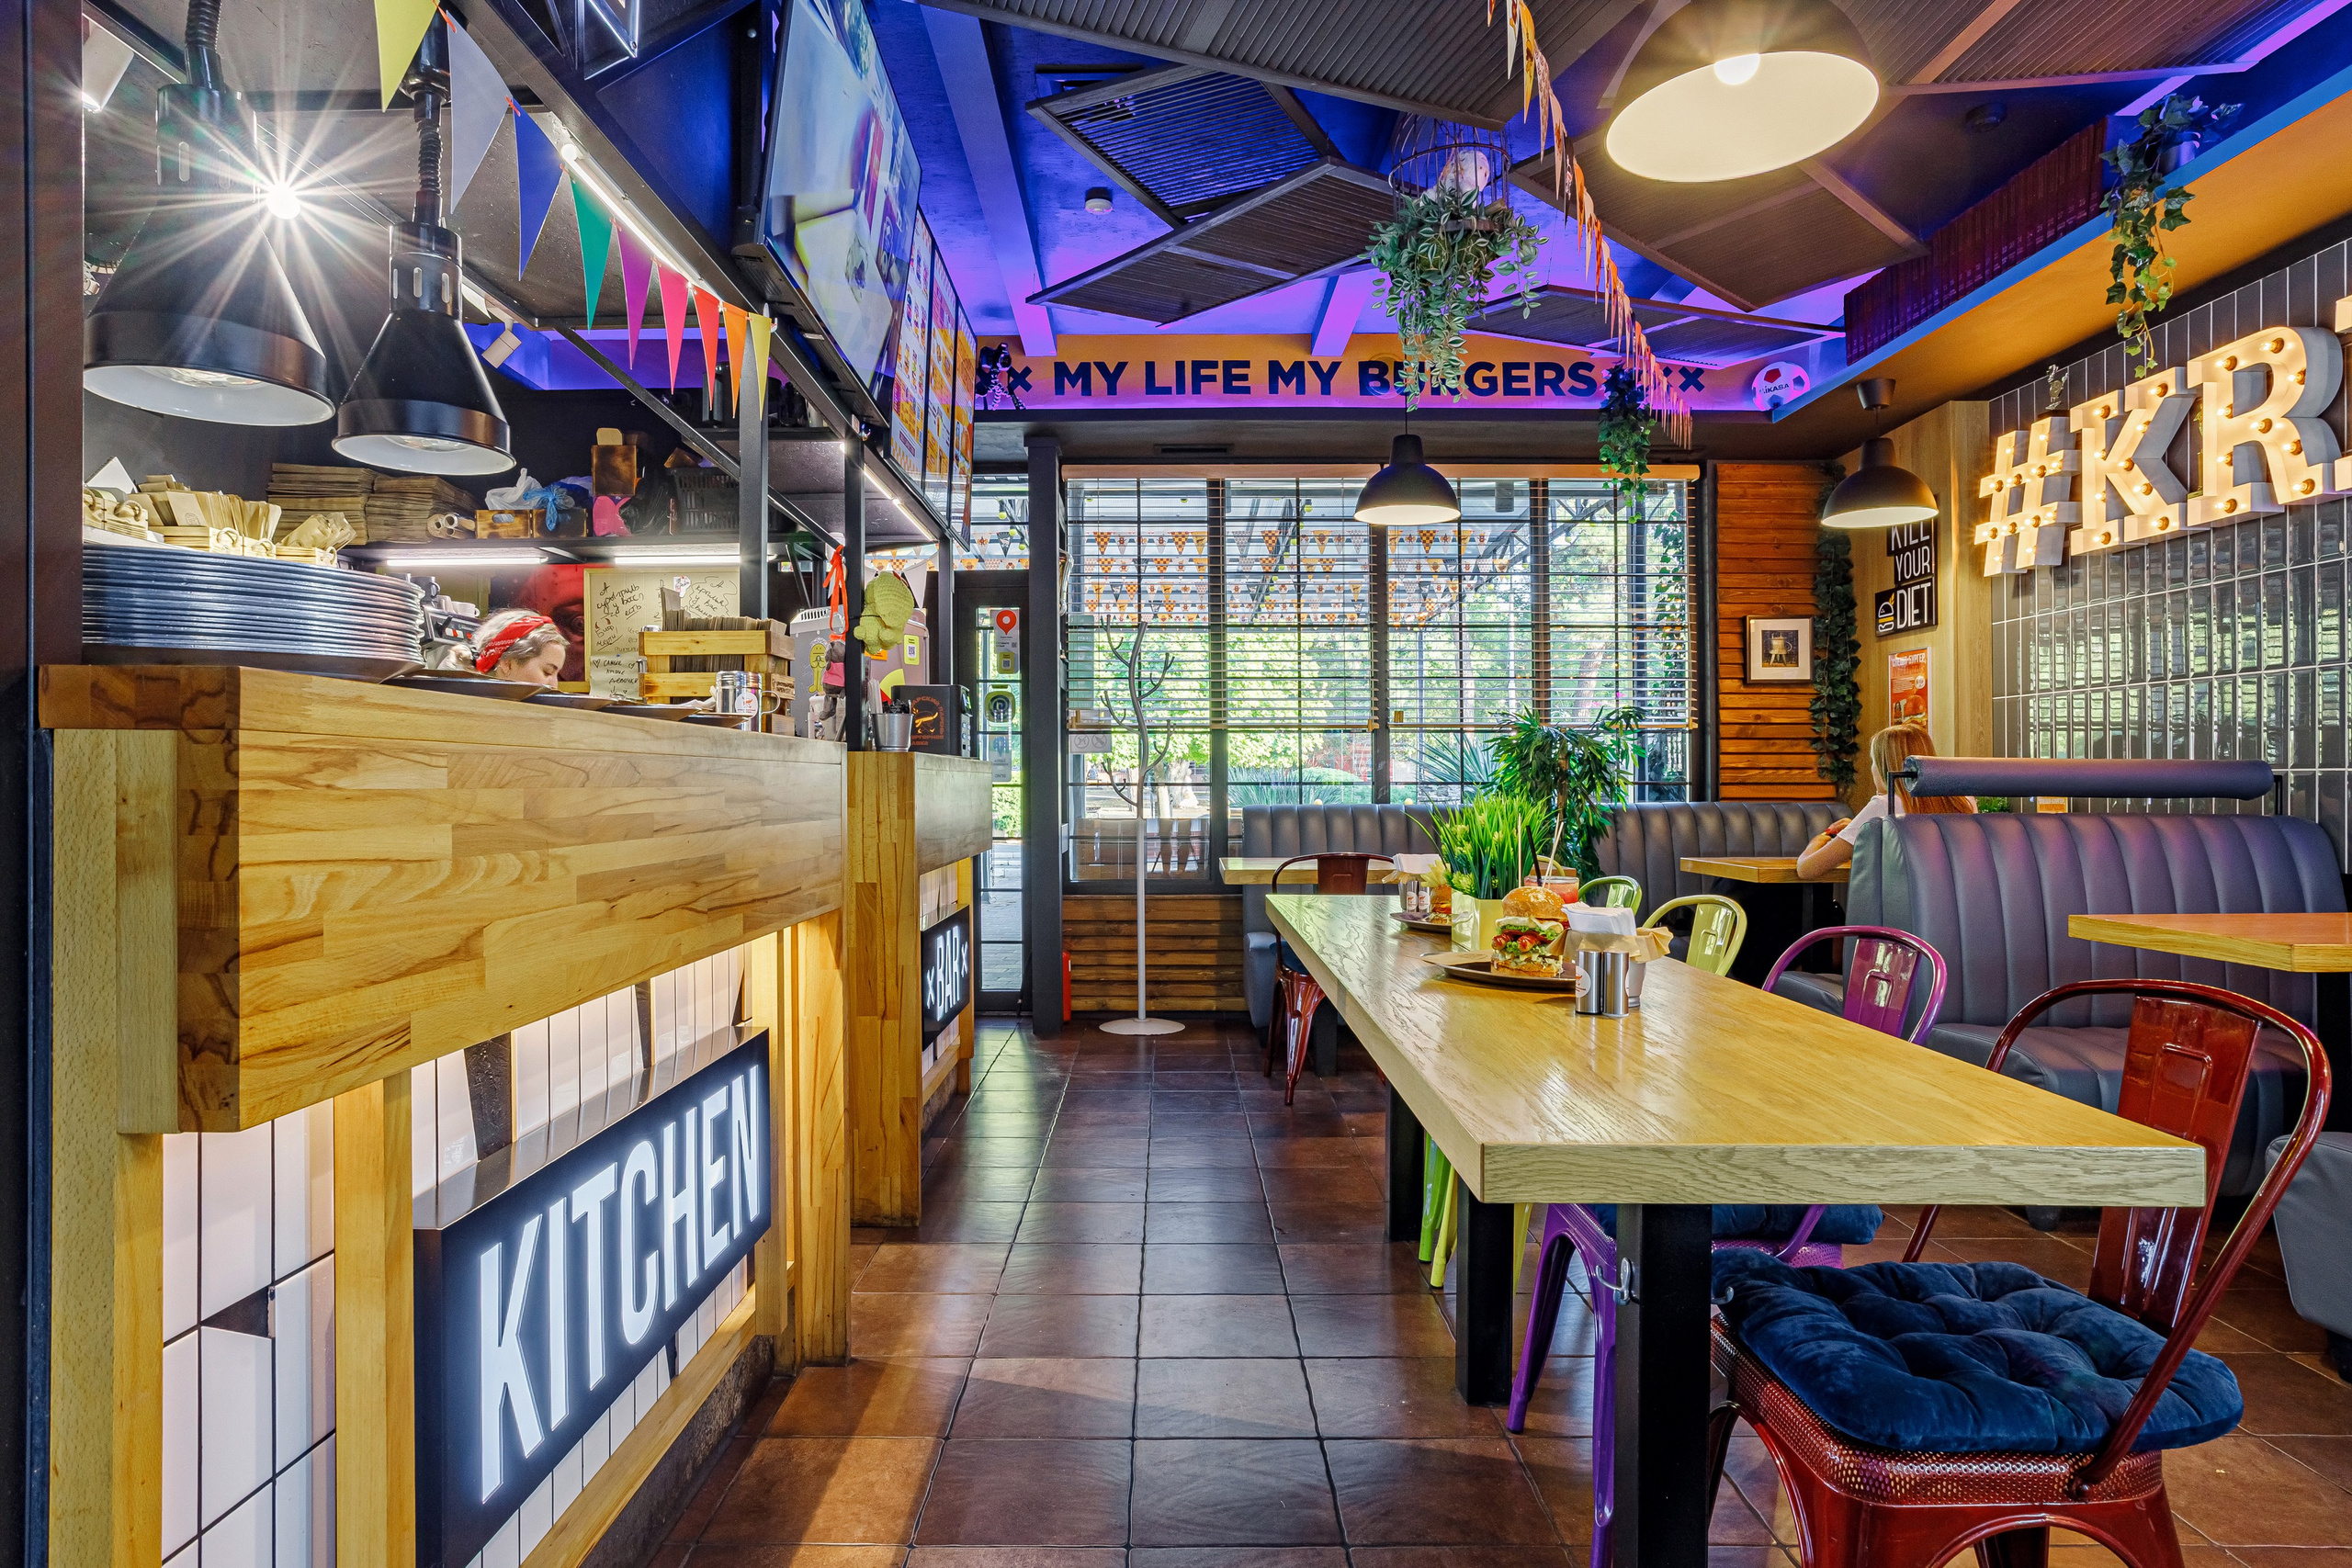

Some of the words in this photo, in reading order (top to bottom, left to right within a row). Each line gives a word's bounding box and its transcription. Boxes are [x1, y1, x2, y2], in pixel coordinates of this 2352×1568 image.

[1054, 361, 1129, 396] MY
[1145, 360, 1251, 396] LIFE
[1268, 360, 1342, 396] MY
[1974, 296, 2352, 577] #KR
[1891, 521, 1930, 551] KILL
[1895, 546, 1930, 581] YOUR
[1896, 581, 1931, 629] DIET
[936, 925, 961, 1022] BAR
[481, 1065, 760, 1504] KITCHEN
